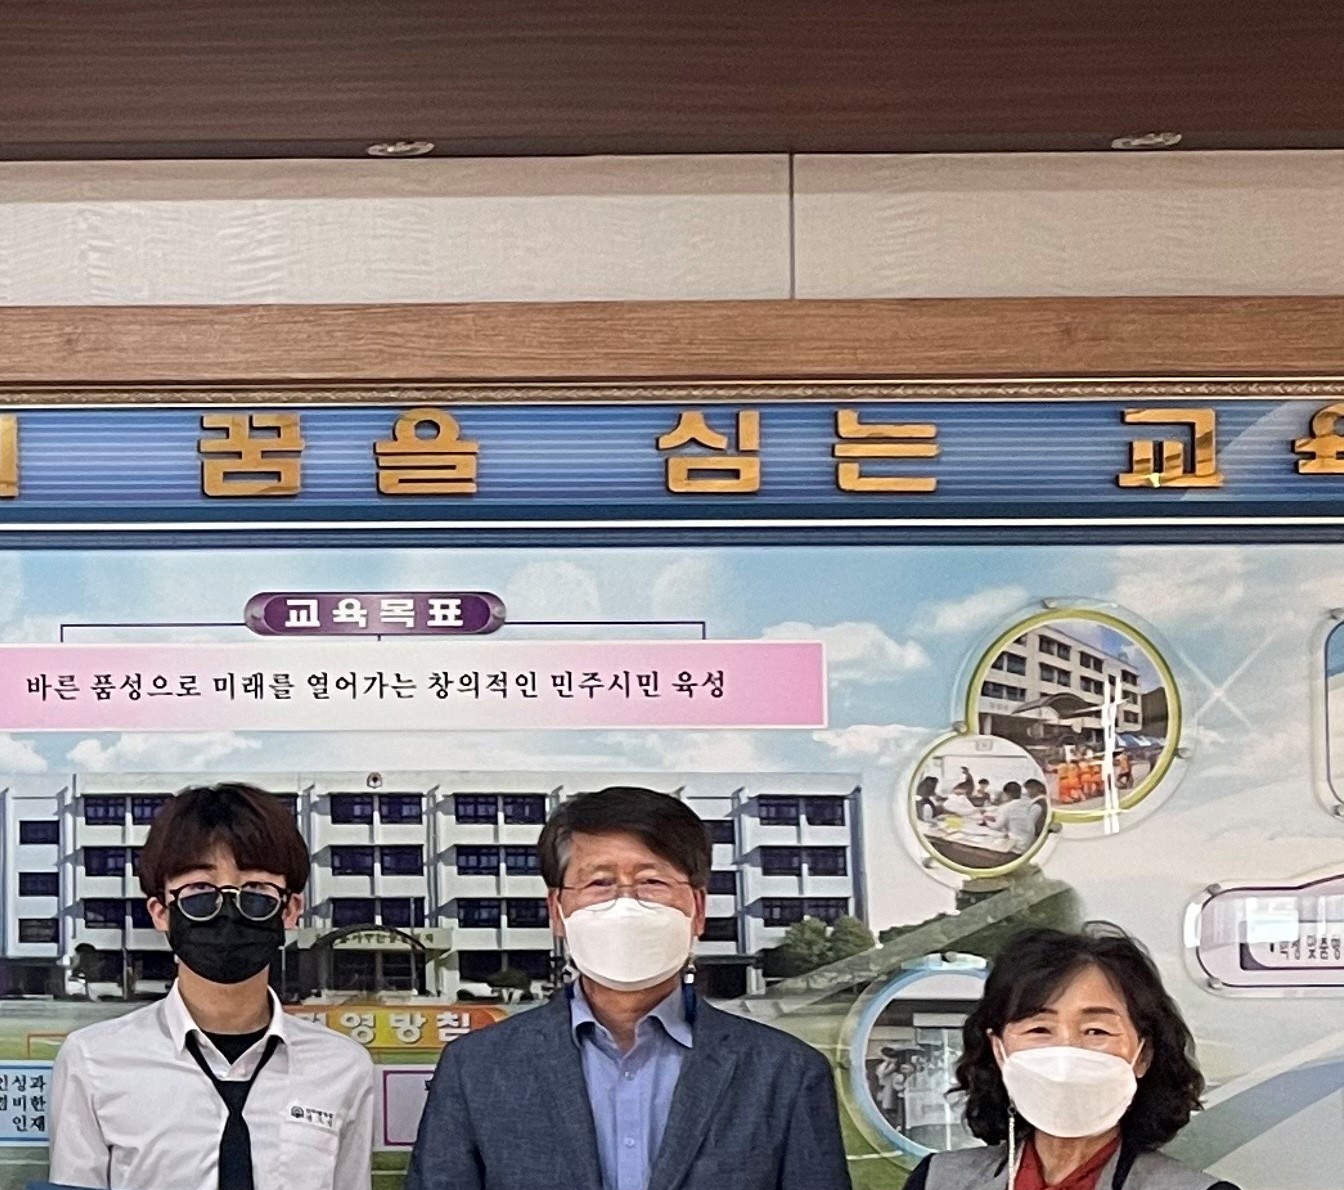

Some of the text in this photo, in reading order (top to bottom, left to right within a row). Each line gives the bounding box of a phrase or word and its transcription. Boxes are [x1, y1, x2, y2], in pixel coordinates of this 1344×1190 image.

[198, 410, 479, 497] 꿈을
[656, 408, 940, 493] 심는
[285, 598, 464, 628] 교육목표
[26, 670, 725, 701] 바른 품성으로 미래를 열어가는 창의적인 민주시민 육성
[12, 1114, 46, 1133] 인재
